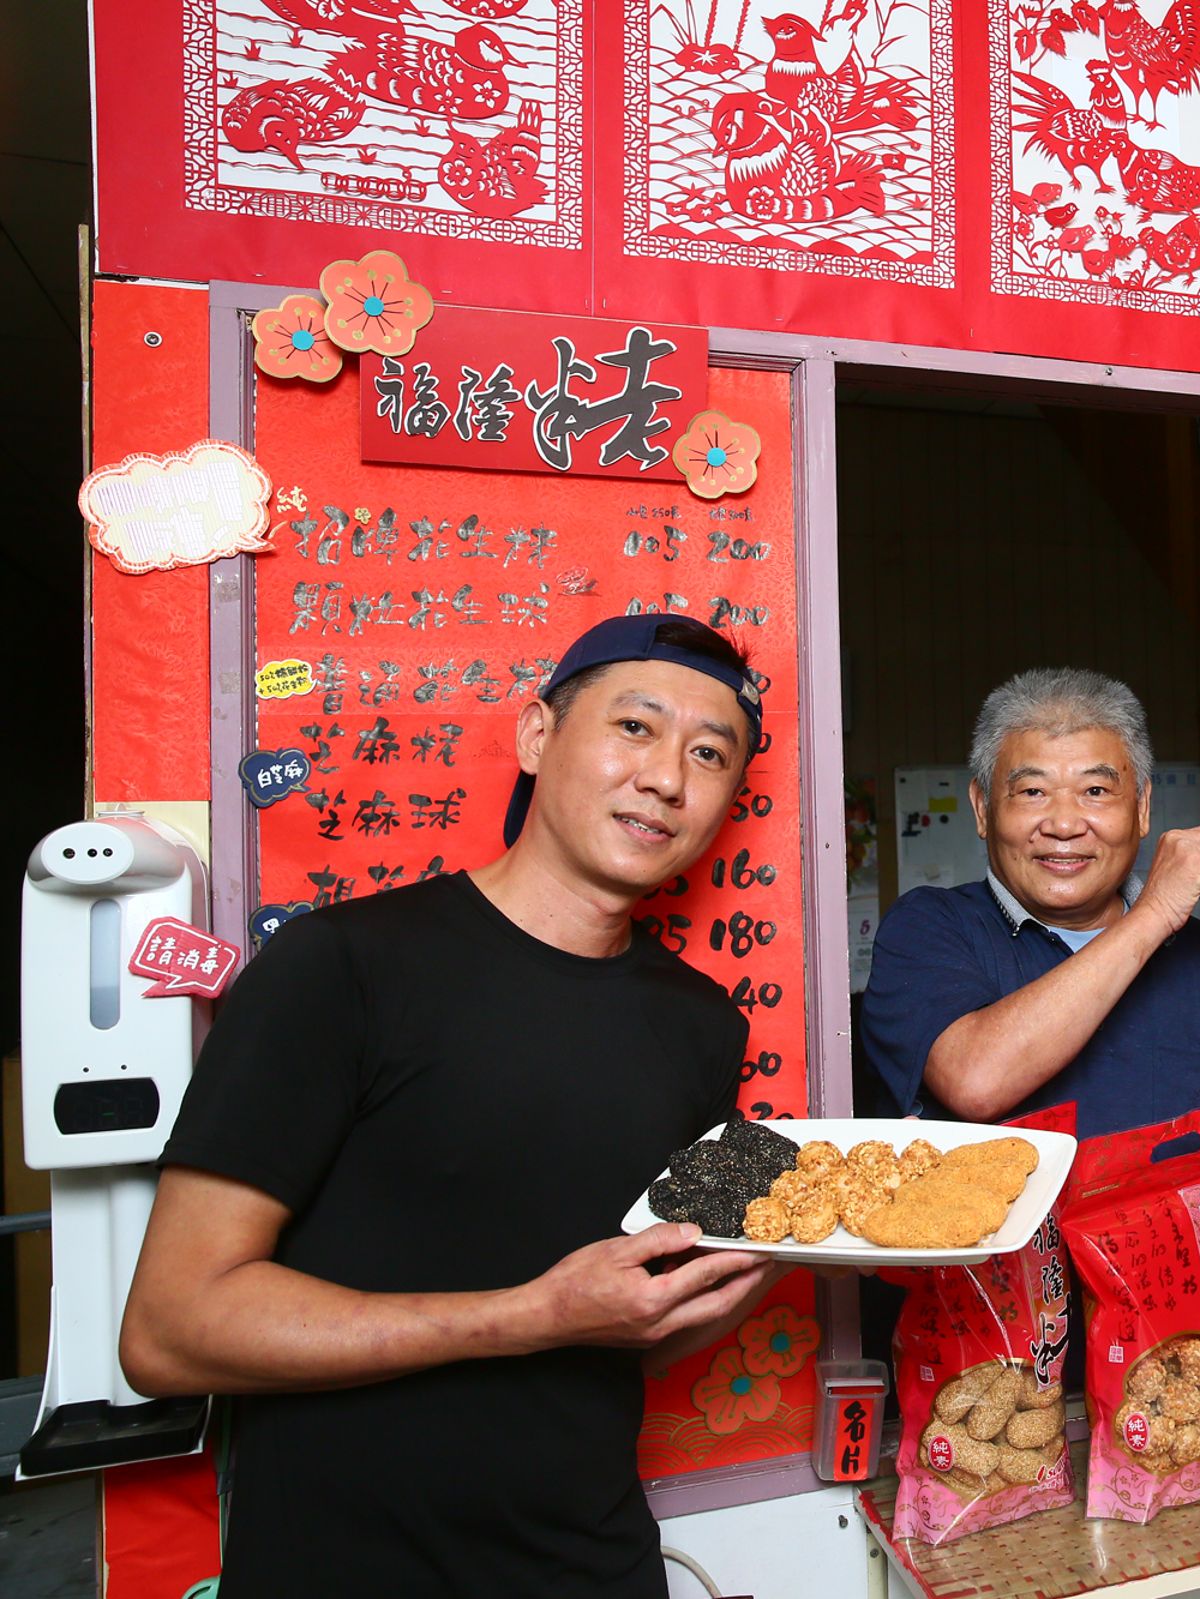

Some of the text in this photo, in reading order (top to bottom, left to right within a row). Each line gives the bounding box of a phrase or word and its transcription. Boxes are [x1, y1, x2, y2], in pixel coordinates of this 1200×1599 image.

[624, 525, 688, 561] 105
[707, 531, 772, 563] 200
[708, 597, 770, 628] 200
[257, 759, 304, 789] 白芝麻
[305, 787, 772, 839] 芝麻球 50
[712, 848, 777, 889] 160
[709, 911, 777, 958] 180
[147, 937, 219, 975] 請消毒
[731, 976, 782, 1014] 40
[841, 1401, 866, 1474] 名片
[1128, 1420, 1145, 1446] 純素
[932, 1442, 950, 1467] 純素
